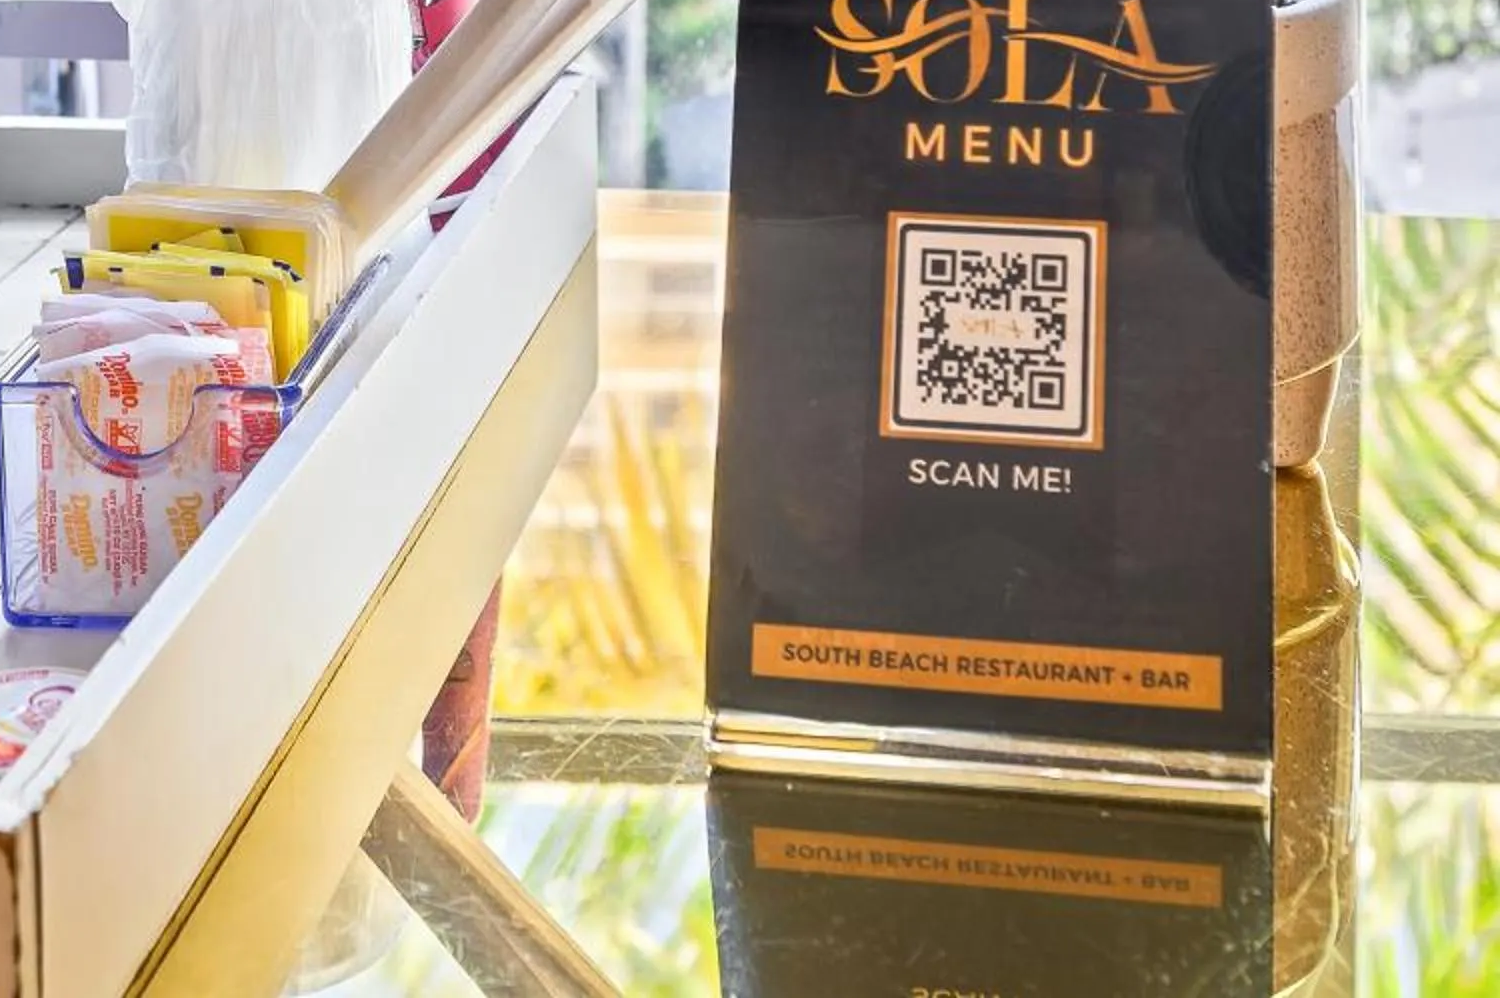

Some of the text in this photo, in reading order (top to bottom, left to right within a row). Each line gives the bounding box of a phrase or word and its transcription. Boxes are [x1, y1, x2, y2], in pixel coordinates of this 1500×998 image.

[905, 122, 1095, 167] MENU
[908, 459, 1072, 494] SCAN ME!
[781, 642, 861, 669] SOUTH
[868, 647, 949, 675] BEACH
[956, 652, 1116, 686] RESTAURANT
[1140, 668, 1190, 692] BAR
